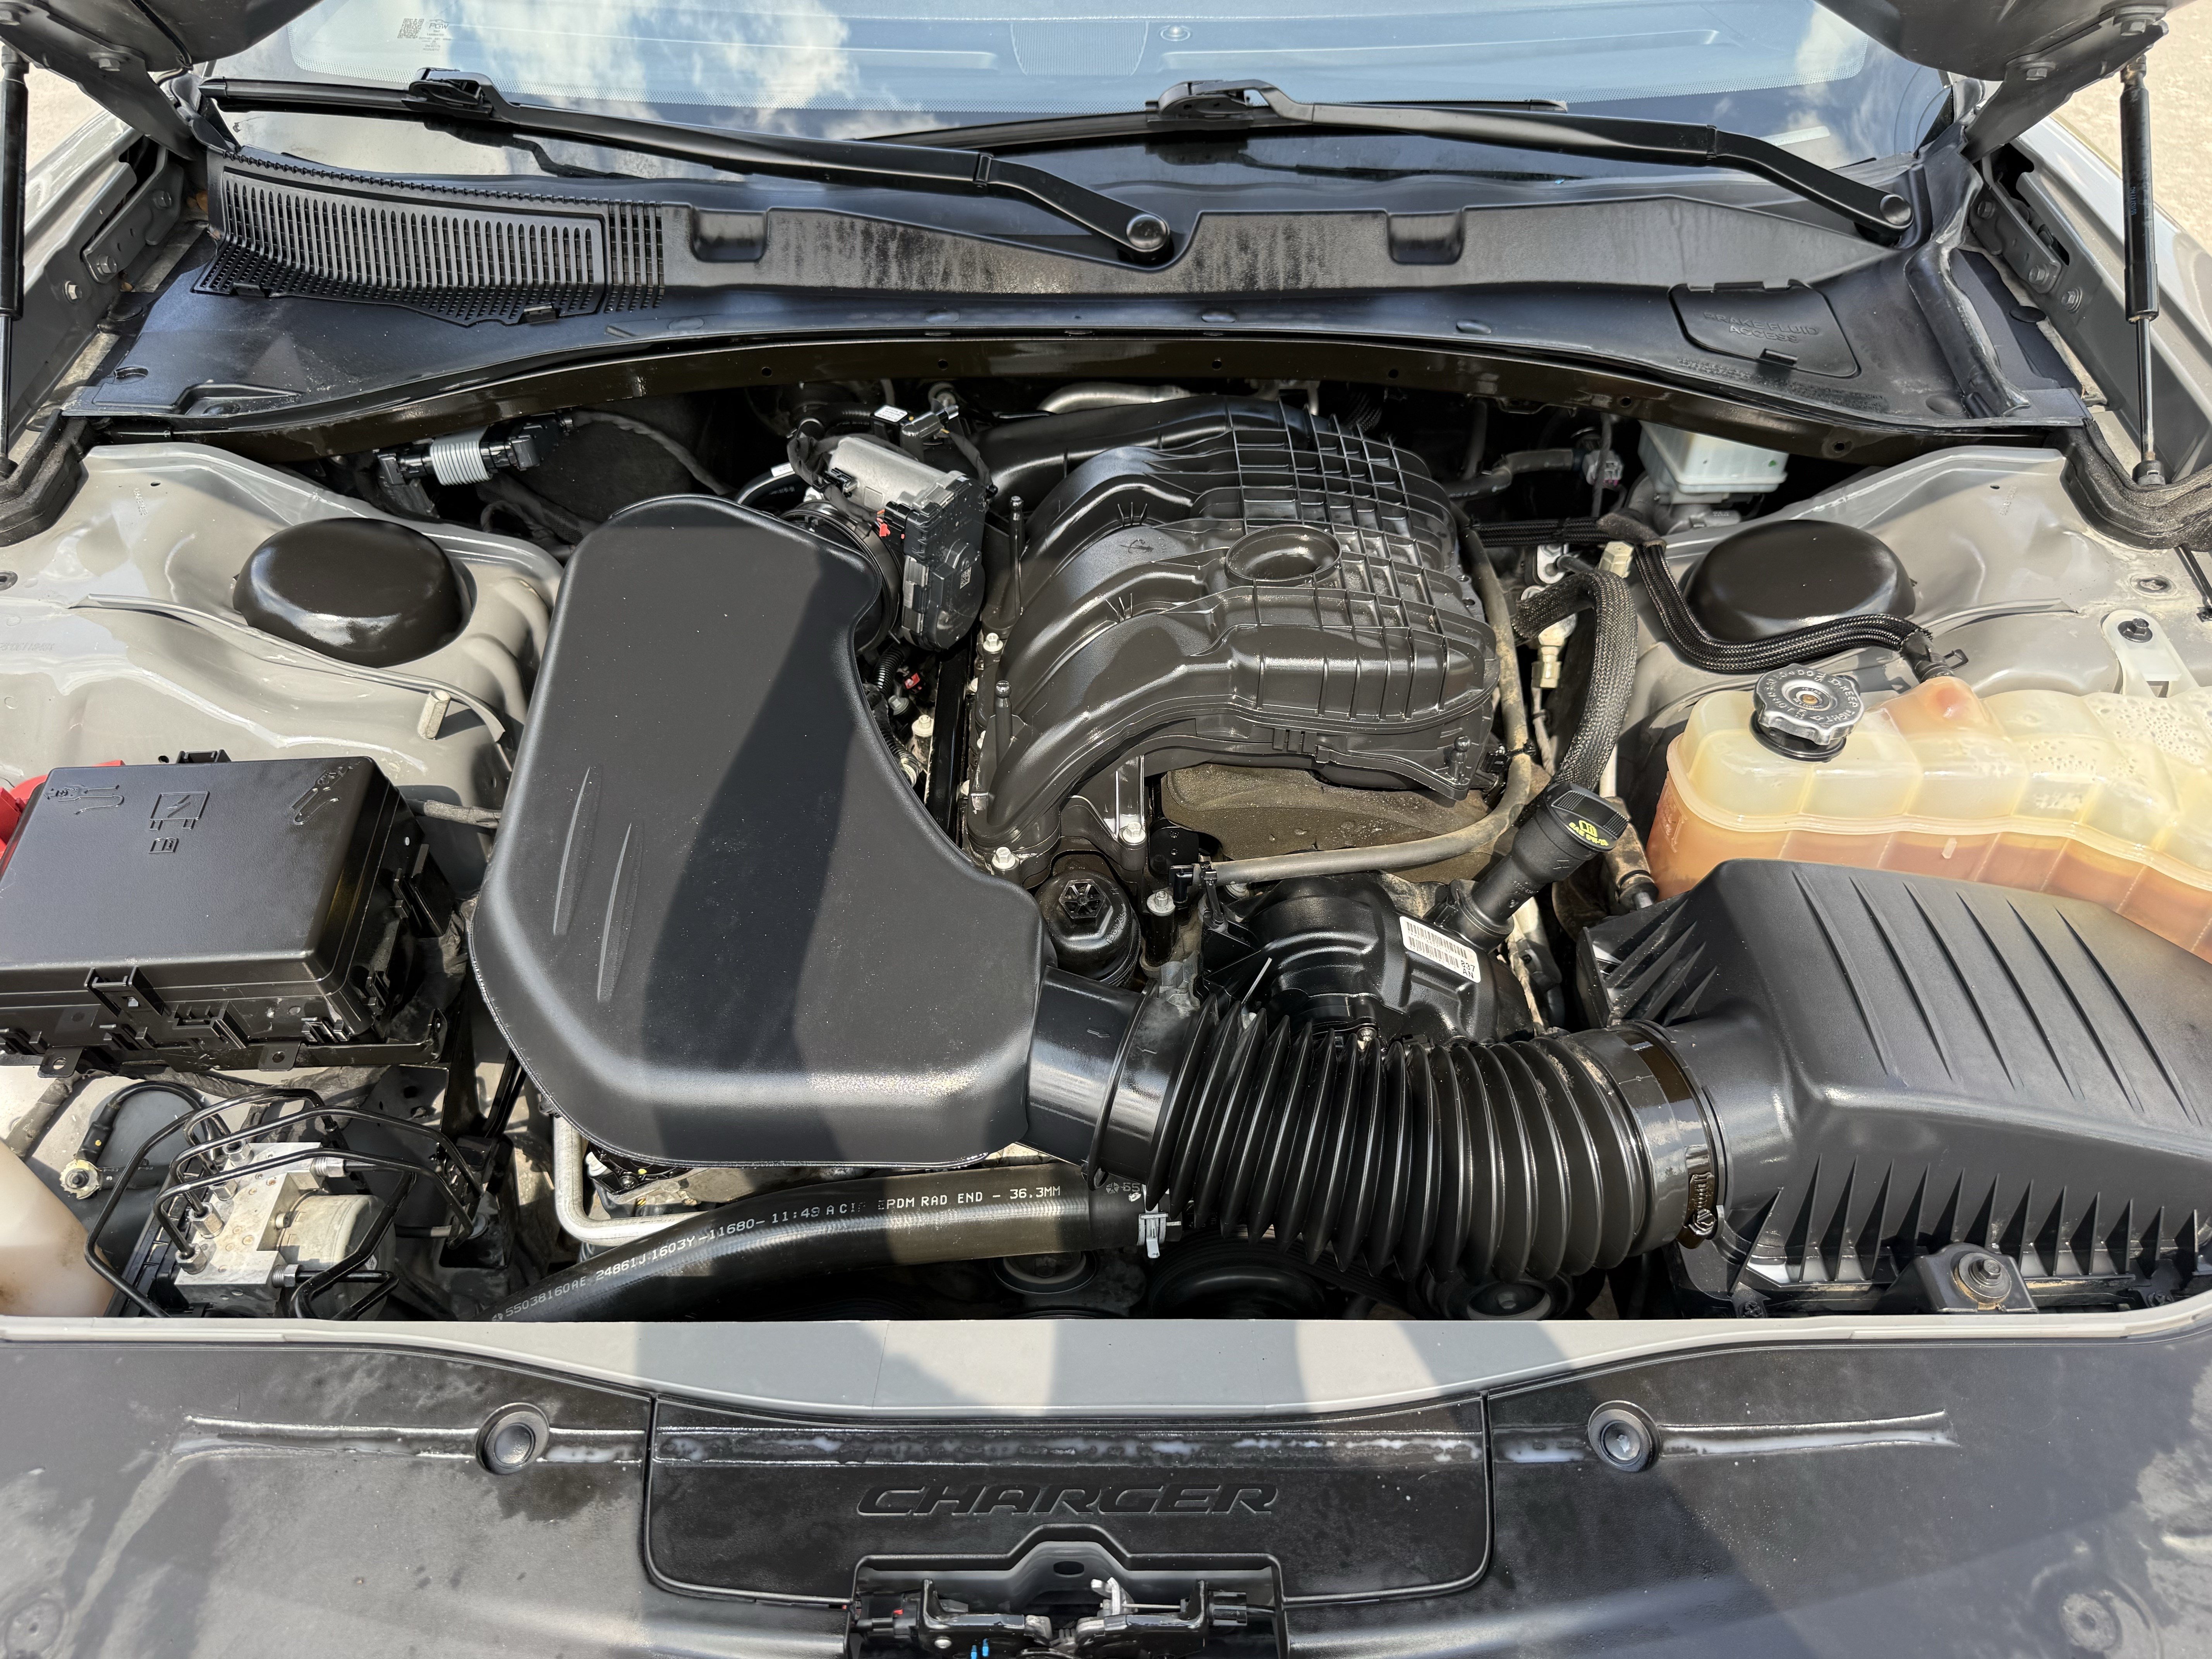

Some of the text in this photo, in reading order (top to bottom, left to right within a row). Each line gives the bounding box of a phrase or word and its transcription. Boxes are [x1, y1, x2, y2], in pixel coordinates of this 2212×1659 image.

[1703, 311, 1820, 335] BRAKE FLUID
[1729, 325, 1800, 343] ACCESS
[1461, 960, 1475, 972] 837
[1463, 968, 1474, 979] AN
[505, 1276, 587, 1317] 55038160AE
[772, 1207, 820, 1224] 11:49
[921, 1194, 948, 1207] RAD
[957, 1192, 983, 1204] END
[1010, 1185, 1061, 1199] 36.3MM
[857, 1483, 1278, 1515] CHARGER
